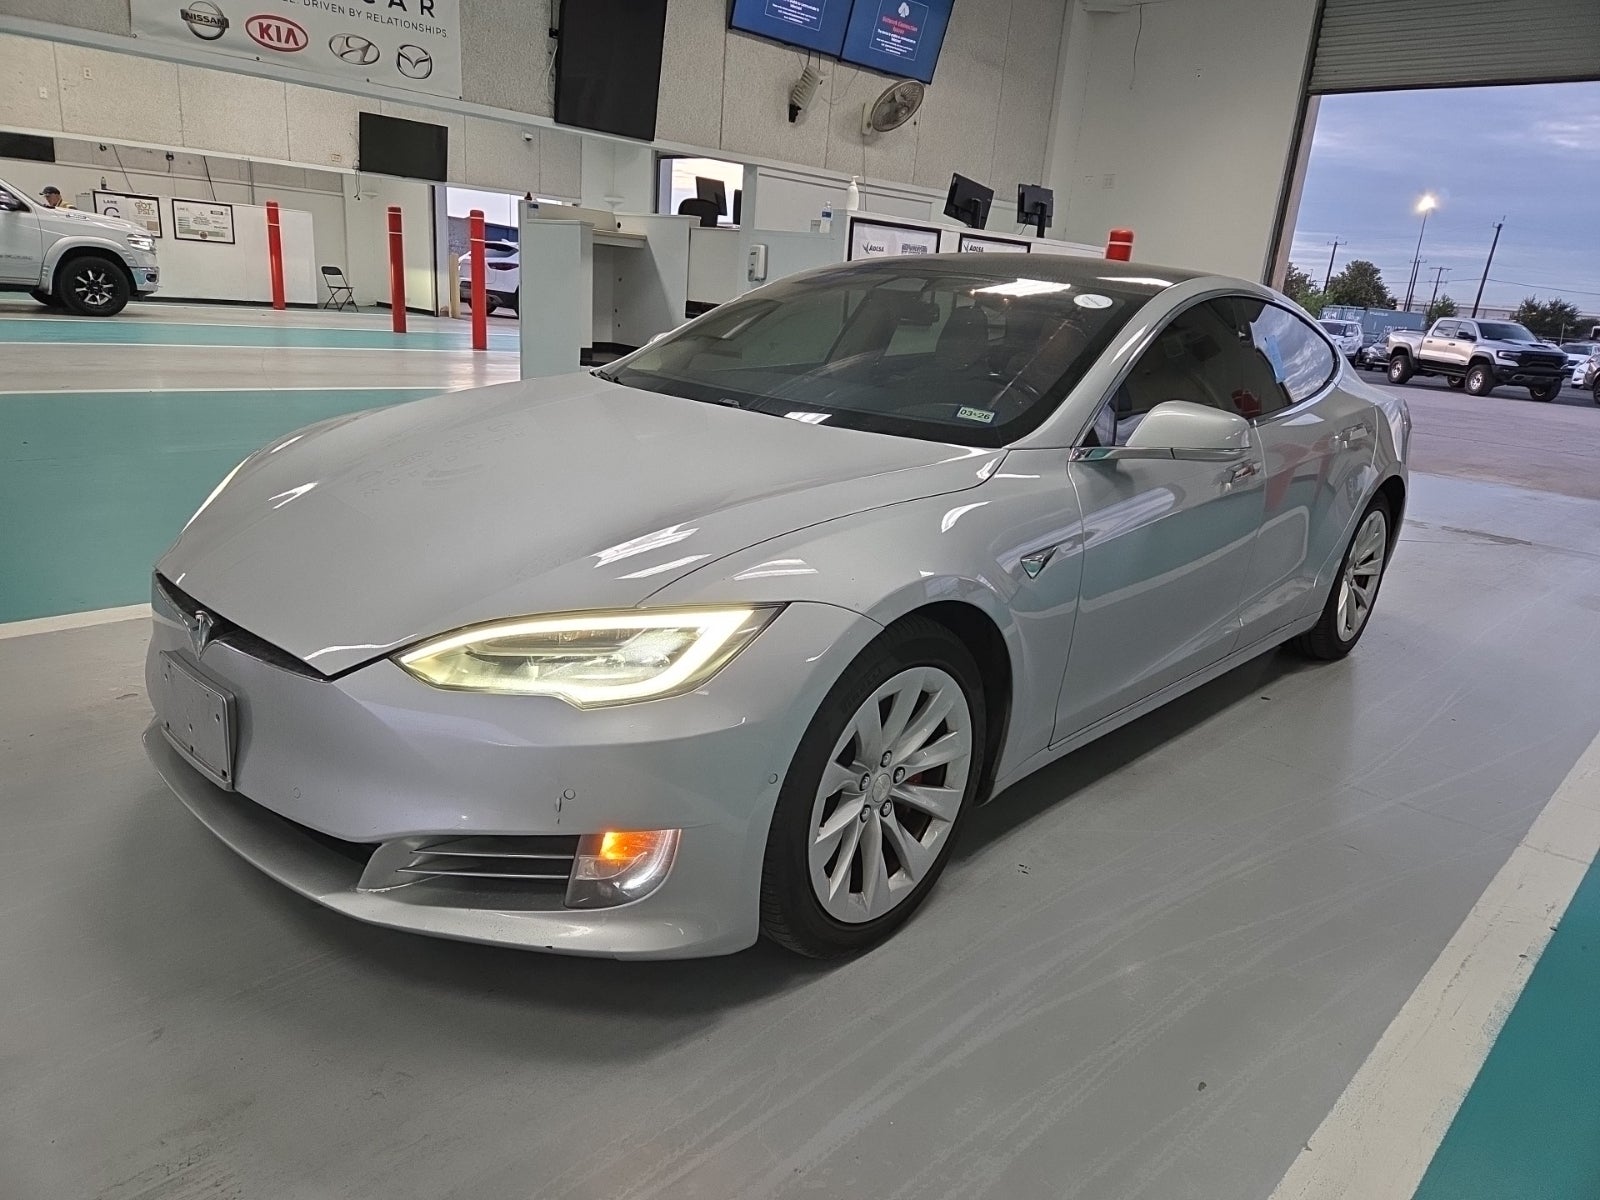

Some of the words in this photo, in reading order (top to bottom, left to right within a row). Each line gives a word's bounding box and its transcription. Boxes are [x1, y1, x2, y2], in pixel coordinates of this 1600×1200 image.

[349, 8, 362, 18] BY
[363, 0, 435, 18] AR
[184, 12, 225, 26] NISSAN
[257, 21, 300, 47] KIA
